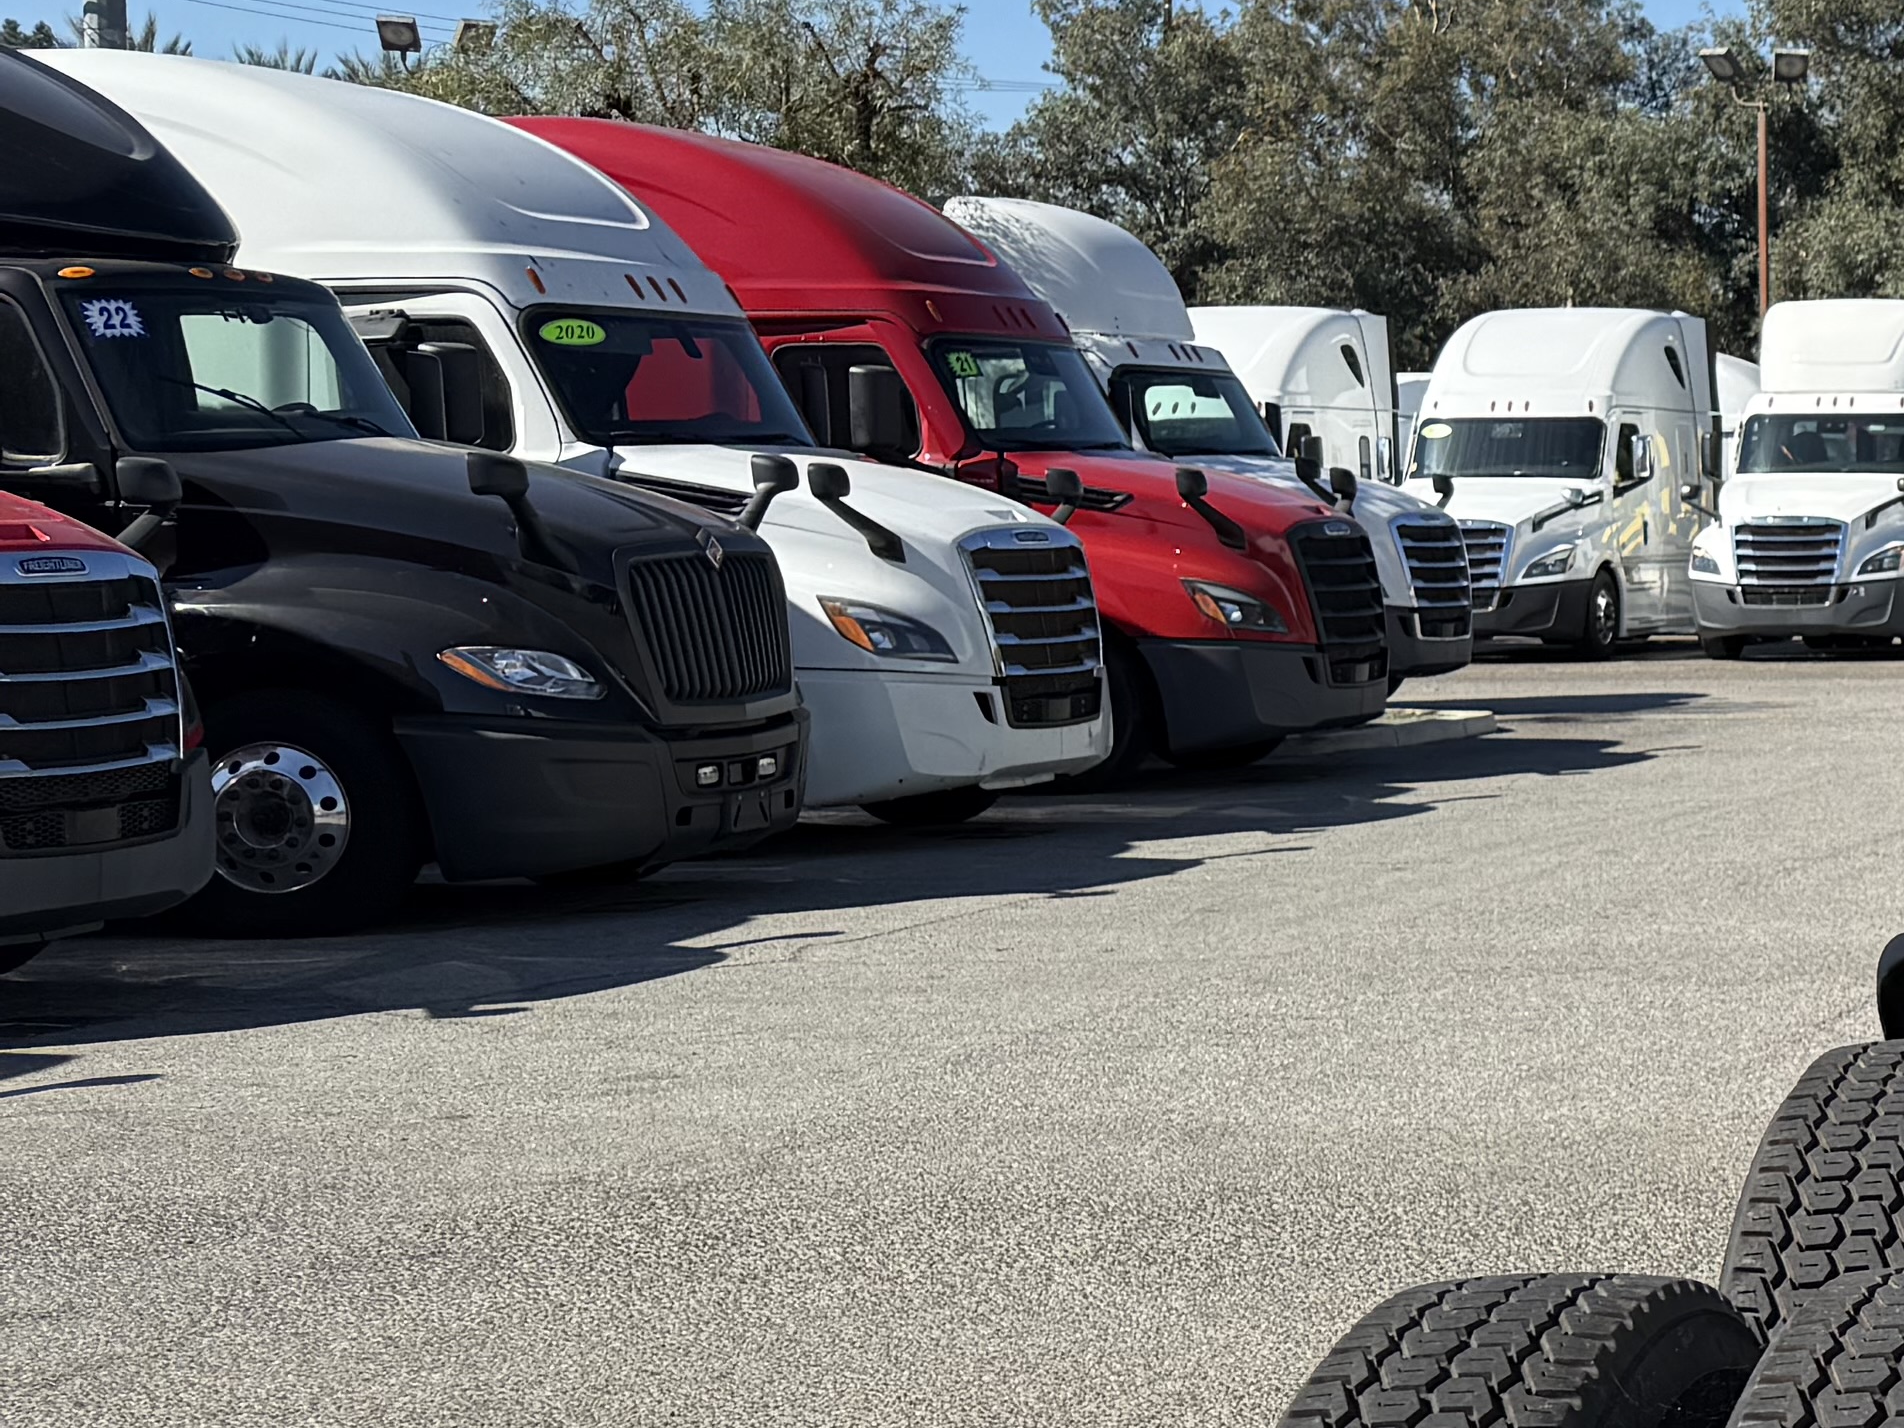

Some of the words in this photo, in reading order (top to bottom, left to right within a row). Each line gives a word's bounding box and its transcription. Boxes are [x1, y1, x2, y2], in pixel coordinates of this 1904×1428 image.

[98, 305, 134, 330] 22
[554, 324, 595, 341] 2020
[955, 356, 974, 373] 21
